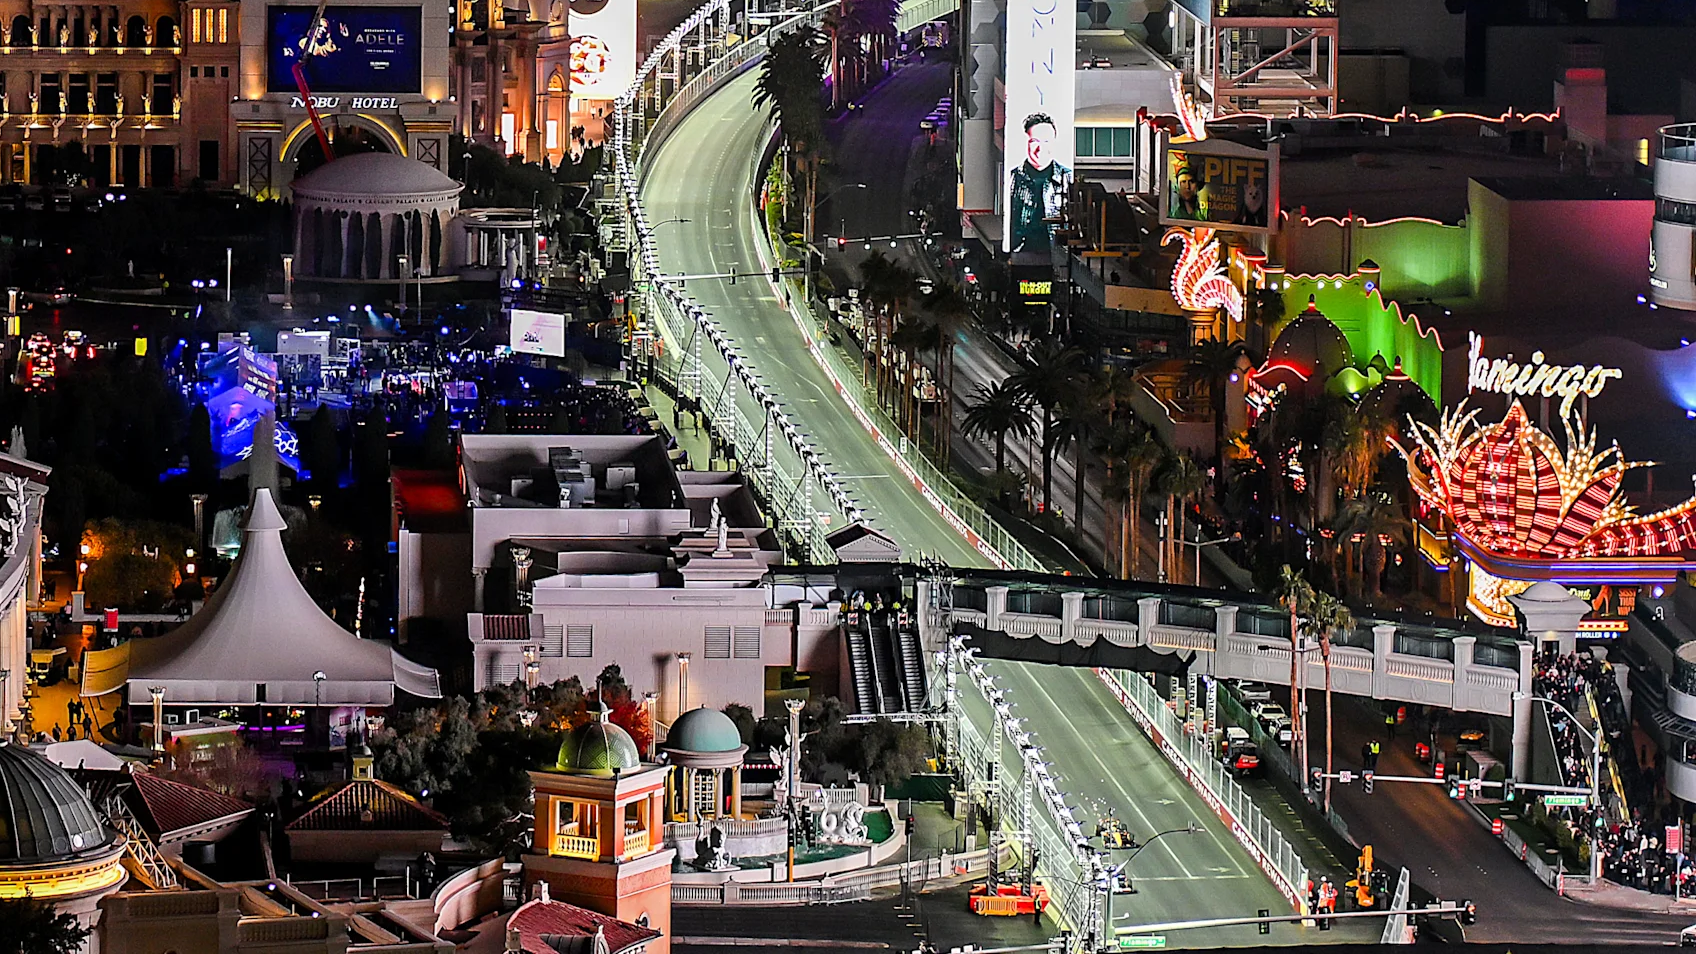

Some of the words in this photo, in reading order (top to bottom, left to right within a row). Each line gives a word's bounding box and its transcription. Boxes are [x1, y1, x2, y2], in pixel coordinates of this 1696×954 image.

[355, 34, 404, 45] ADELE
[352, 98, 398, 109] HOTEL
[1204, 157, 1264, 187] PIFF
[1200, 201, 1237, 212] DRAGON
[1209, 193, 1237, 202] MAGIC
[921, 486, 942, 514] CAESARS
[977, 540, 1003, 570] CAESARS
[1098, 667, 1123, 704] CAESARS
[1123, 695, 1153, 734] REWARDS
[1161, 739, 1189, 778] CAESARS
[1189, 772, 1222, 817] REWARDS
[1231, 821, 1261, 863] CAESARS
[1261, 855, 1295, 907] REWARDS
